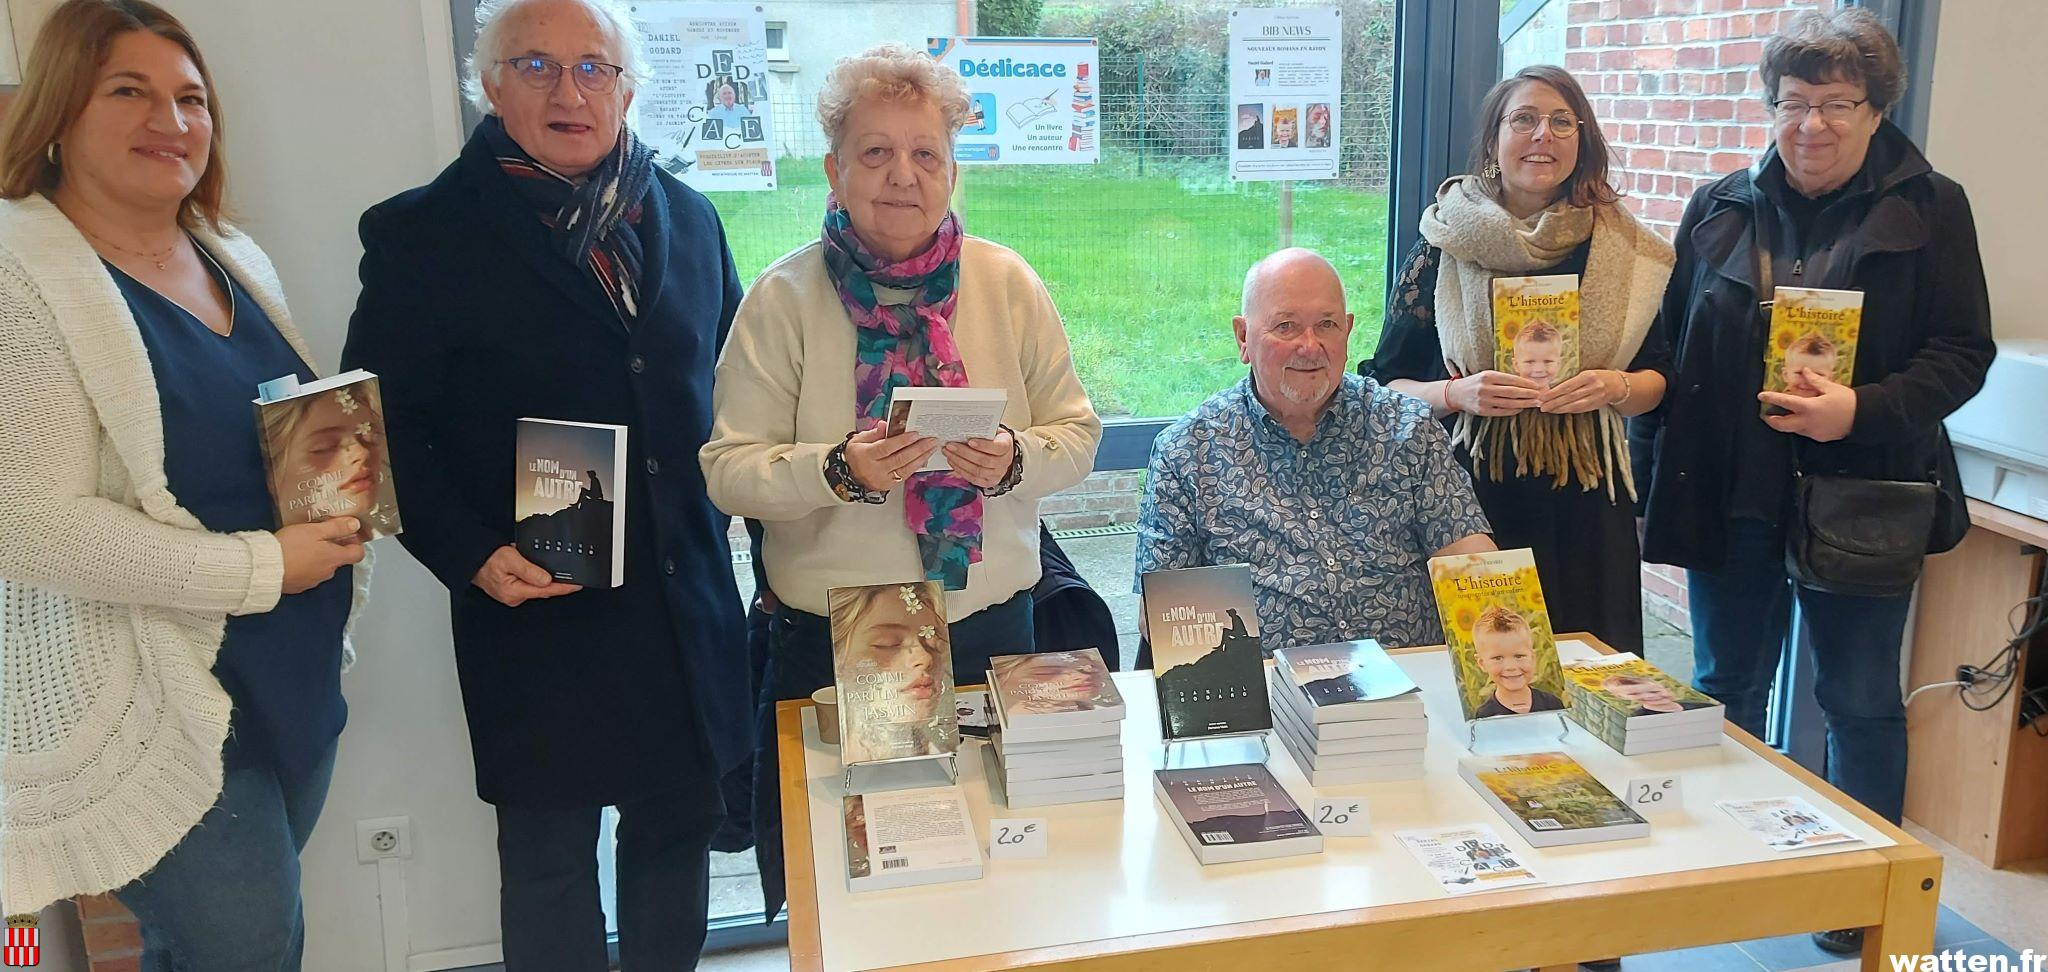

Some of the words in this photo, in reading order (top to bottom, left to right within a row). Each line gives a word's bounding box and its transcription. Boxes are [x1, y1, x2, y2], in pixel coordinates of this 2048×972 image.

[648, 34, 681, 42] DANIEL
[1262, 26, 1280, 36] BIB
[1282, 26, 1312, 36] NEWS
[649, 47, 682, 55] GODARD
[959, 58, 1067, 77] Dédicace
[1507, 295, 1565, 307] L'histoire
[1785, 307, 1845, 321] L'histoire
[529, 462, 537, 472] LE
[536, 459, 560, 474] NOM
[560, 468, 577, 481] D'UN
[1453, 573, 1522, 590] L'histoire
[1162, 612, 1171, 622] LE
[1170, 605, 1196, 622] NOM
[1196, 612, 1217, 624] D'UN
[1564, 663, 1633, 674] L'histoire
[857, 671, 904, 685] COMME
[864, 703, 917, 721] JASMIN
[1215, 783, 1233, 791] D'UN
[1233, 780, 1258, 789] AUTRE
[1637, 779, 1673, 804] 20€
[1319, 803, 1360, 824] 20€
[997, 823, 1037, 845] 20€
